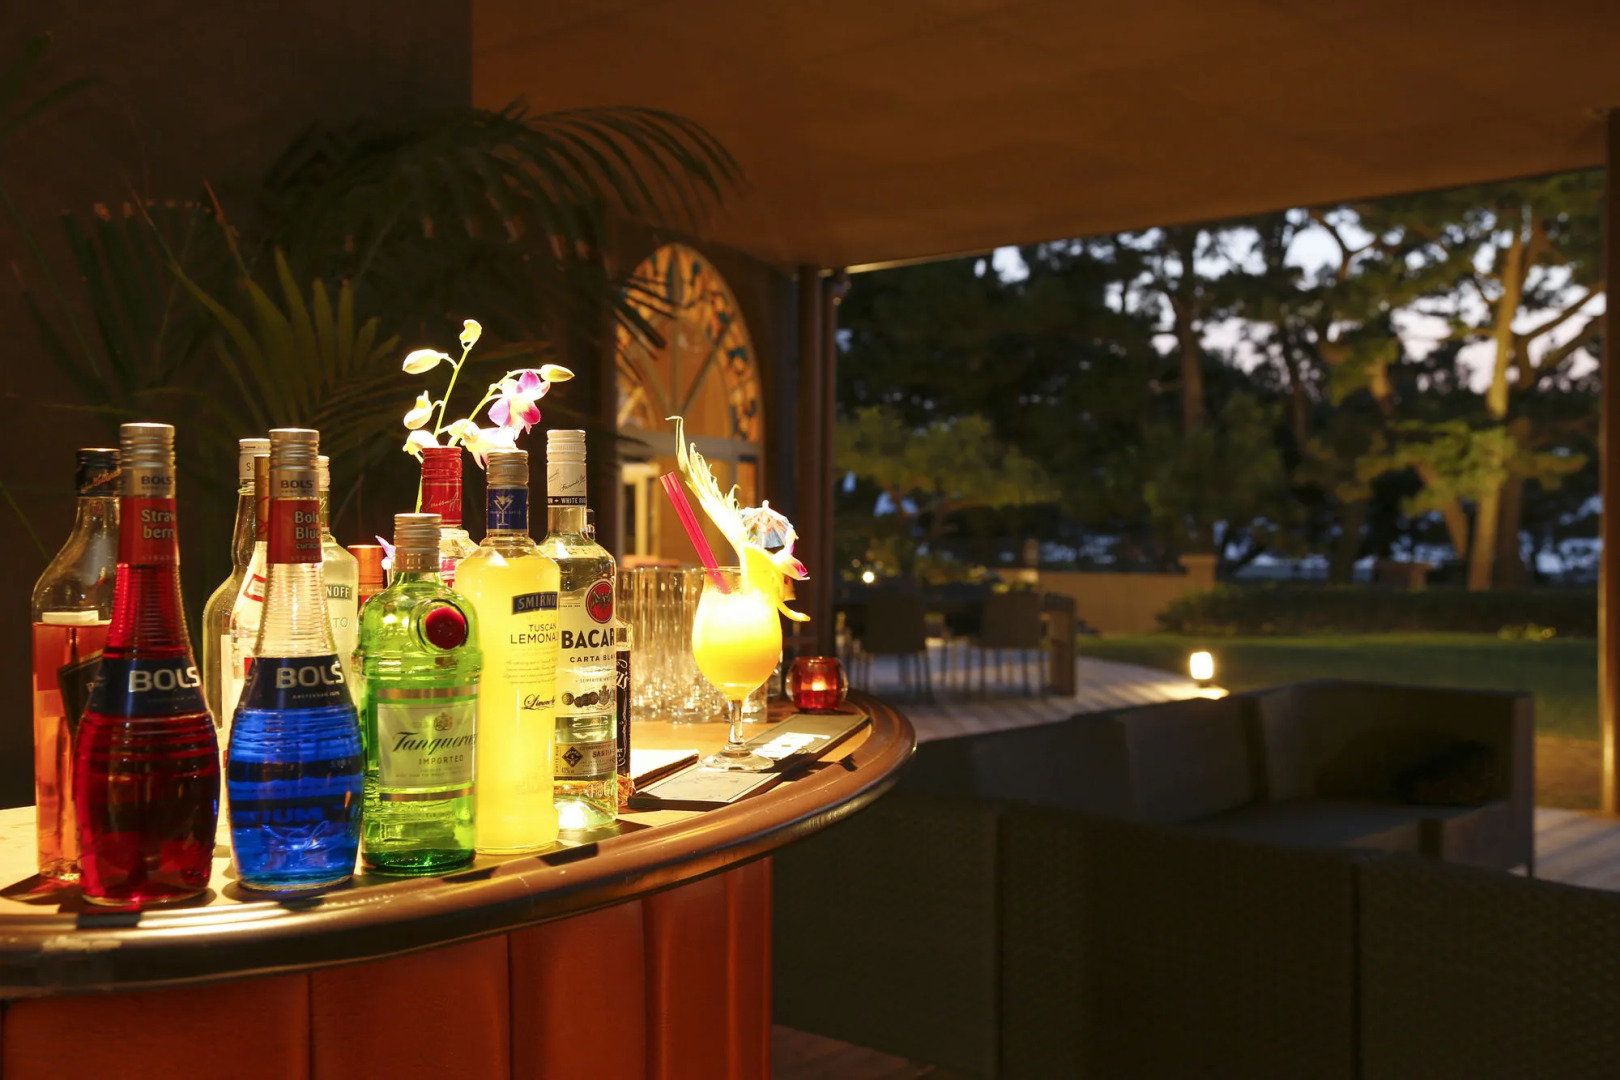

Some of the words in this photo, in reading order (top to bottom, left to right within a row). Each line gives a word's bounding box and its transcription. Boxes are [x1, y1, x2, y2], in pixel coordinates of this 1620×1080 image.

[141, 475, 172, 486] BOLS
[280, 480, 313, 489] BOLS
[128, 666, 200, 693] BOLS
[276, 660, 344, 689] BOLS
[419, 754, 464, 766] IMPORTED
